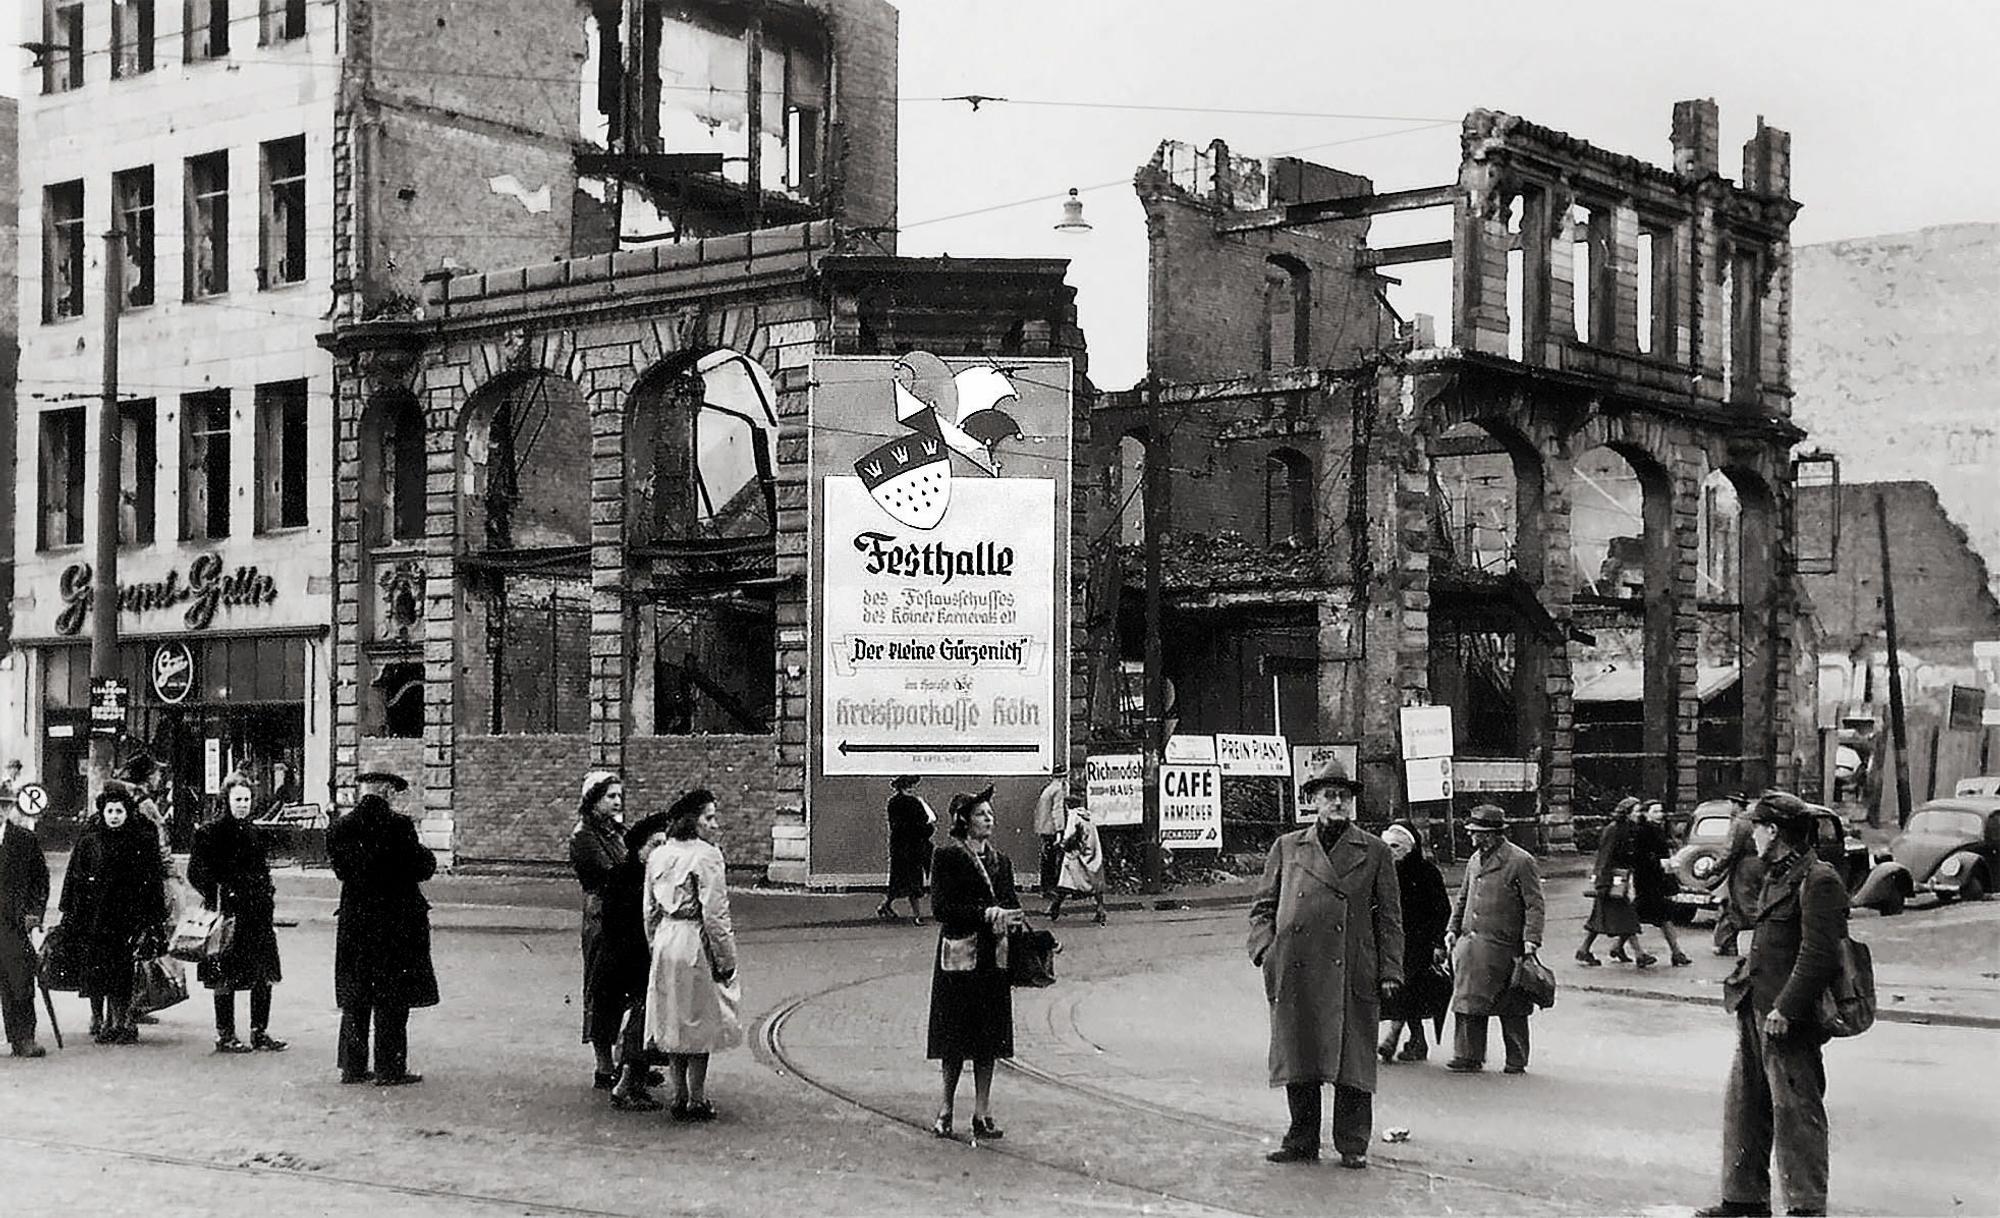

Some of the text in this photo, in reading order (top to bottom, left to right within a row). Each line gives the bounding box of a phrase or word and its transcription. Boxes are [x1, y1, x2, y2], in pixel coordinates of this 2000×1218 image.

[853, 531, 1014, 584] Festhalle
[863, 589, 888, 606] des
[993, 696, 1040, 726] Köln
[1164, 769, 1212, 797] CAFÉ
